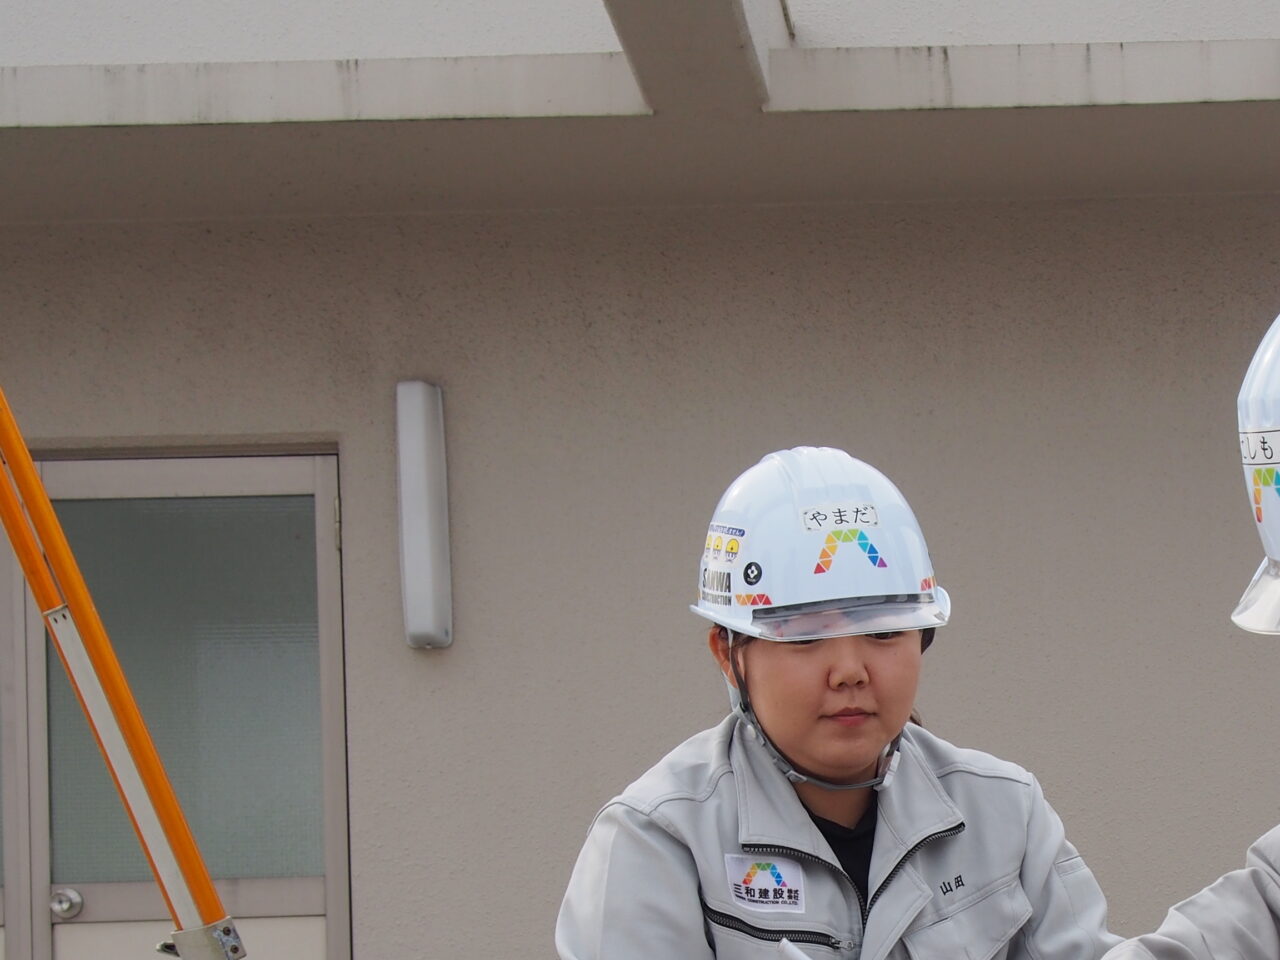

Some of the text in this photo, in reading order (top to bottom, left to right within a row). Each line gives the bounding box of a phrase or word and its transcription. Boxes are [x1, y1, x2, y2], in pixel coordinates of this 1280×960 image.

[809, 506, 870, 527] やまだ
[733, 883, 785, 900] 三和建設
[940, 874, 965, 895] 山田
